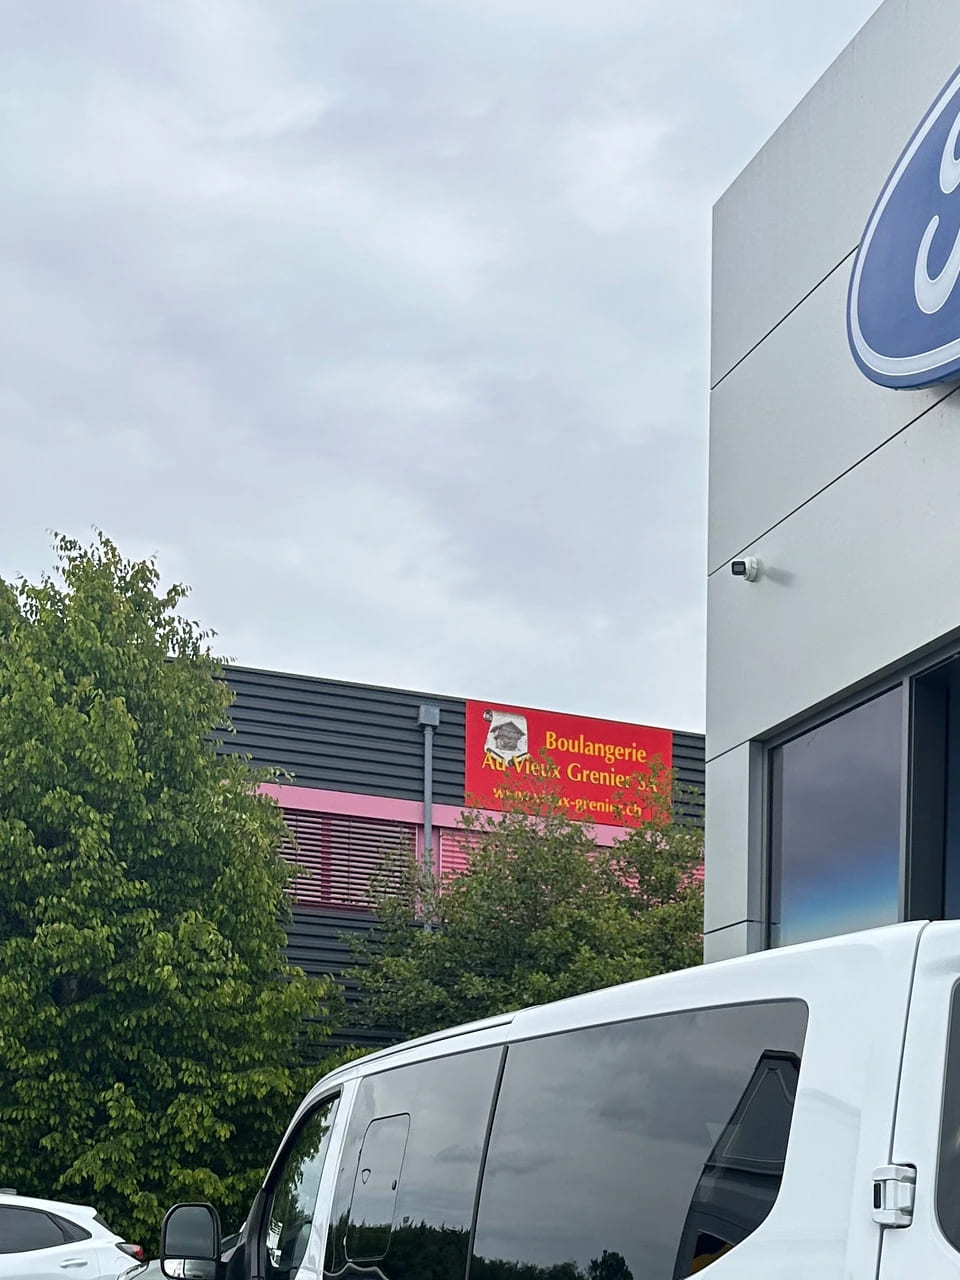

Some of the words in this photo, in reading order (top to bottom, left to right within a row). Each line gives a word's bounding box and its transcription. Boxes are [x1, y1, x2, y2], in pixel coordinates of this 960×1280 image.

[546, 731, 647, 764] Boulangerie
[482, 752, 506, 772] Au
[513, 755, 561, 779] Vieux
[567, 763, 632, 788] Grenier
